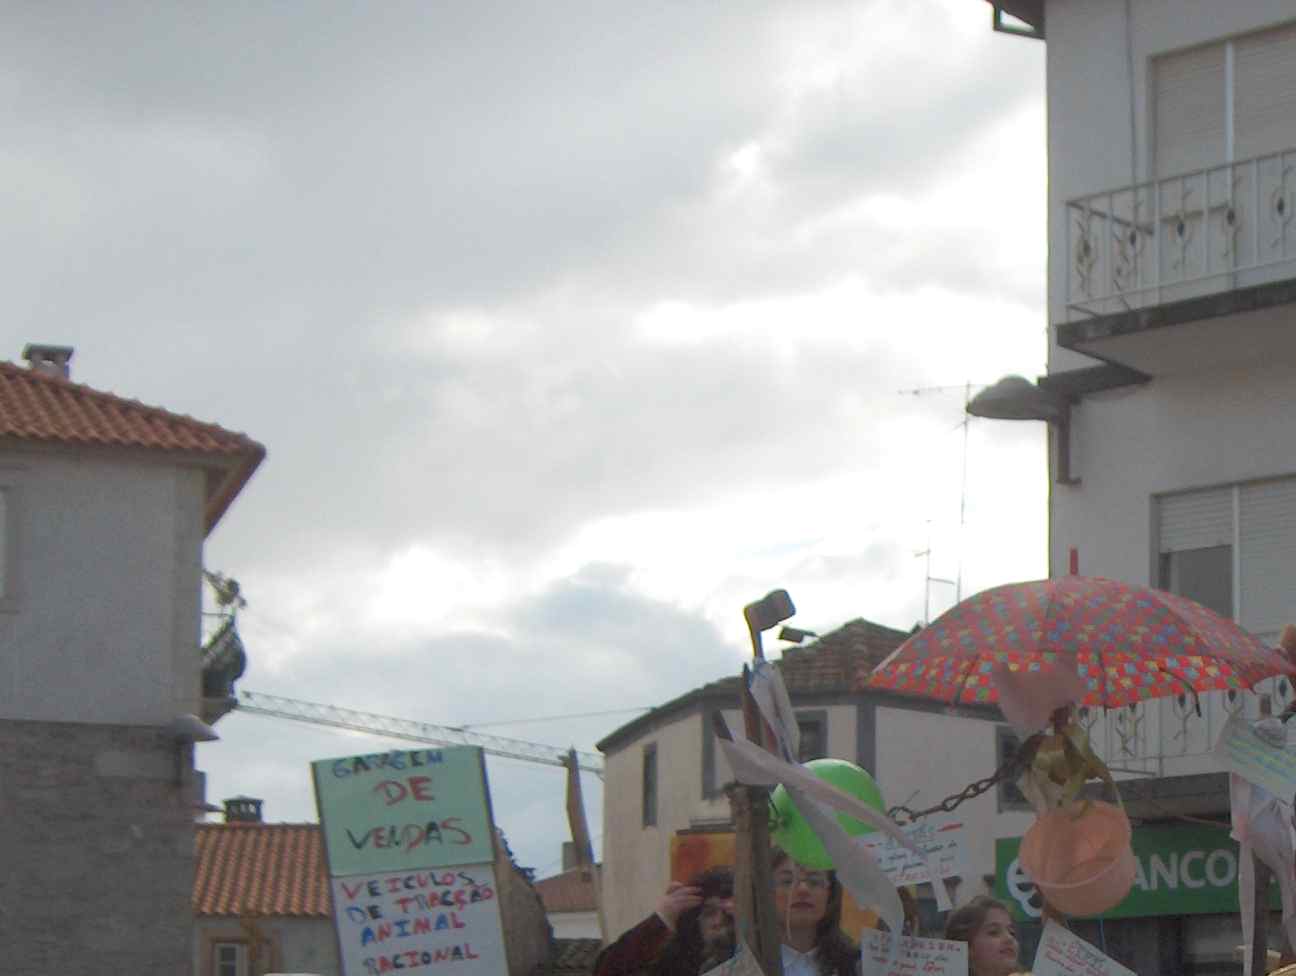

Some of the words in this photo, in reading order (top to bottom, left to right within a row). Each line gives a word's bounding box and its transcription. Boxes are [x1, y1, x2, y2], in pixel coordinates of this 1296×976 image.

[374, 775, 435, 806] DE
[346, 817, 473, 853] VENDAS
[1134, 848, 1238, 891] ANCO
[345, 904, 384, 925] DE
[361, 912, 466, 947] ANIMAL
[362, 942, 481, 976] RACIONAL
